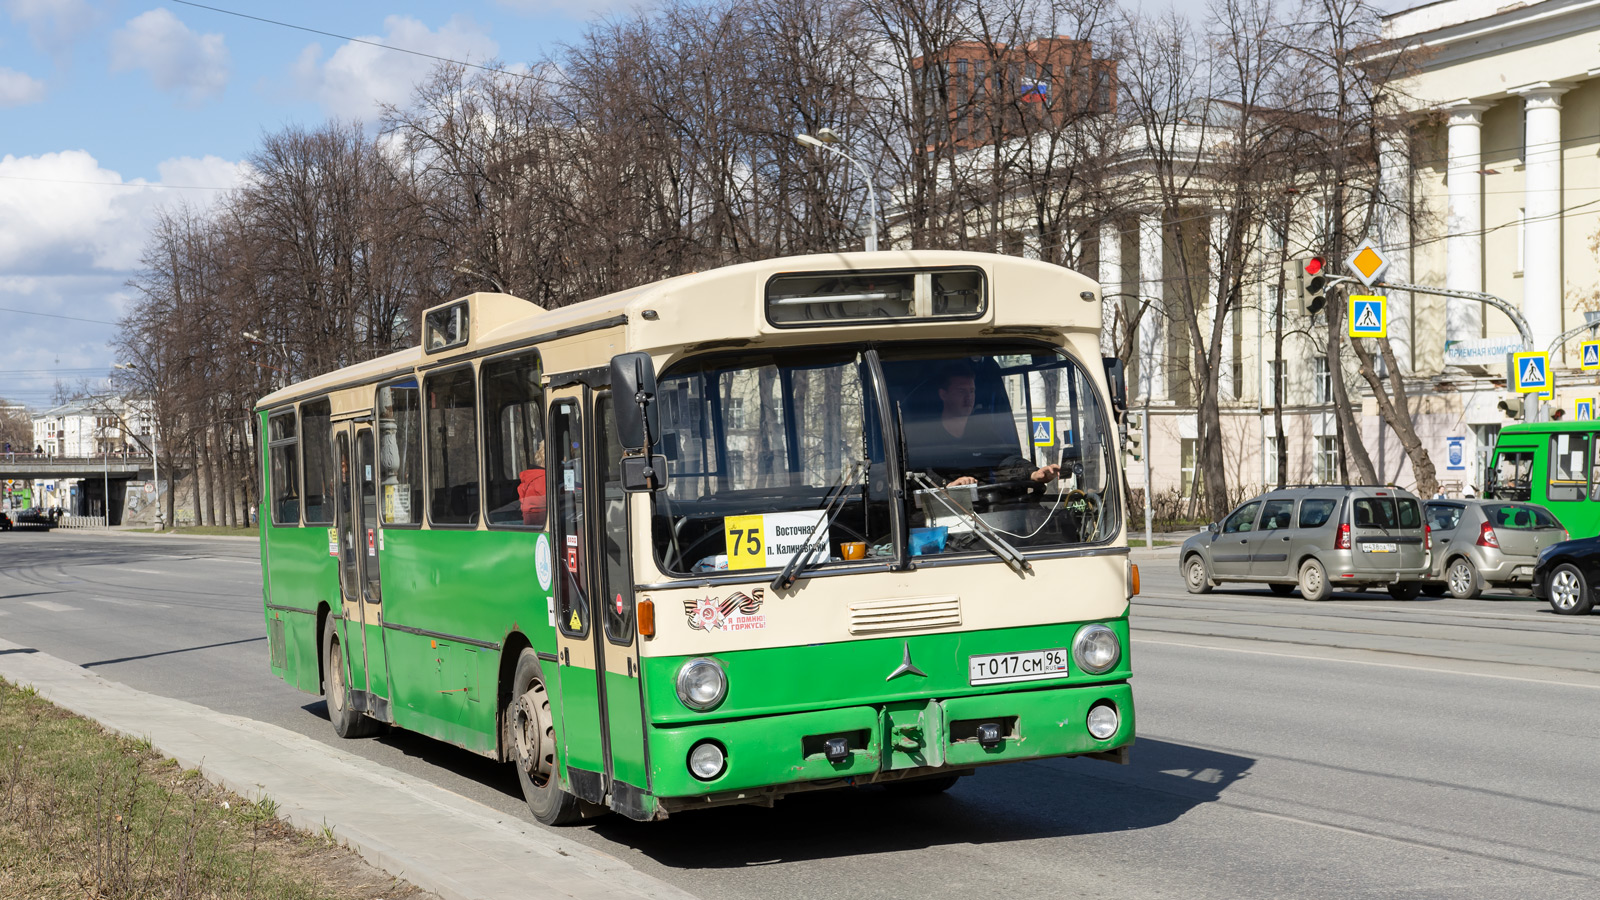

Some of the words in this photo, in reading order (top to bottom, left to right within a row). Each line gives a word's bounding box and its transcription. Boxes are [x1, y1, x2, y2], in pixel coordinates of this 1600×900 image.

[775, 525, 815, 536] Восточная
[729, 528, 761, 556] 75
[767, 546, 774, 555] п.
[731, 622, 766, 630] ГОРЖУСЬ!
[978, 656, 1042, 676] Т017СМ
[1046, 652, 1061, 665] 96
